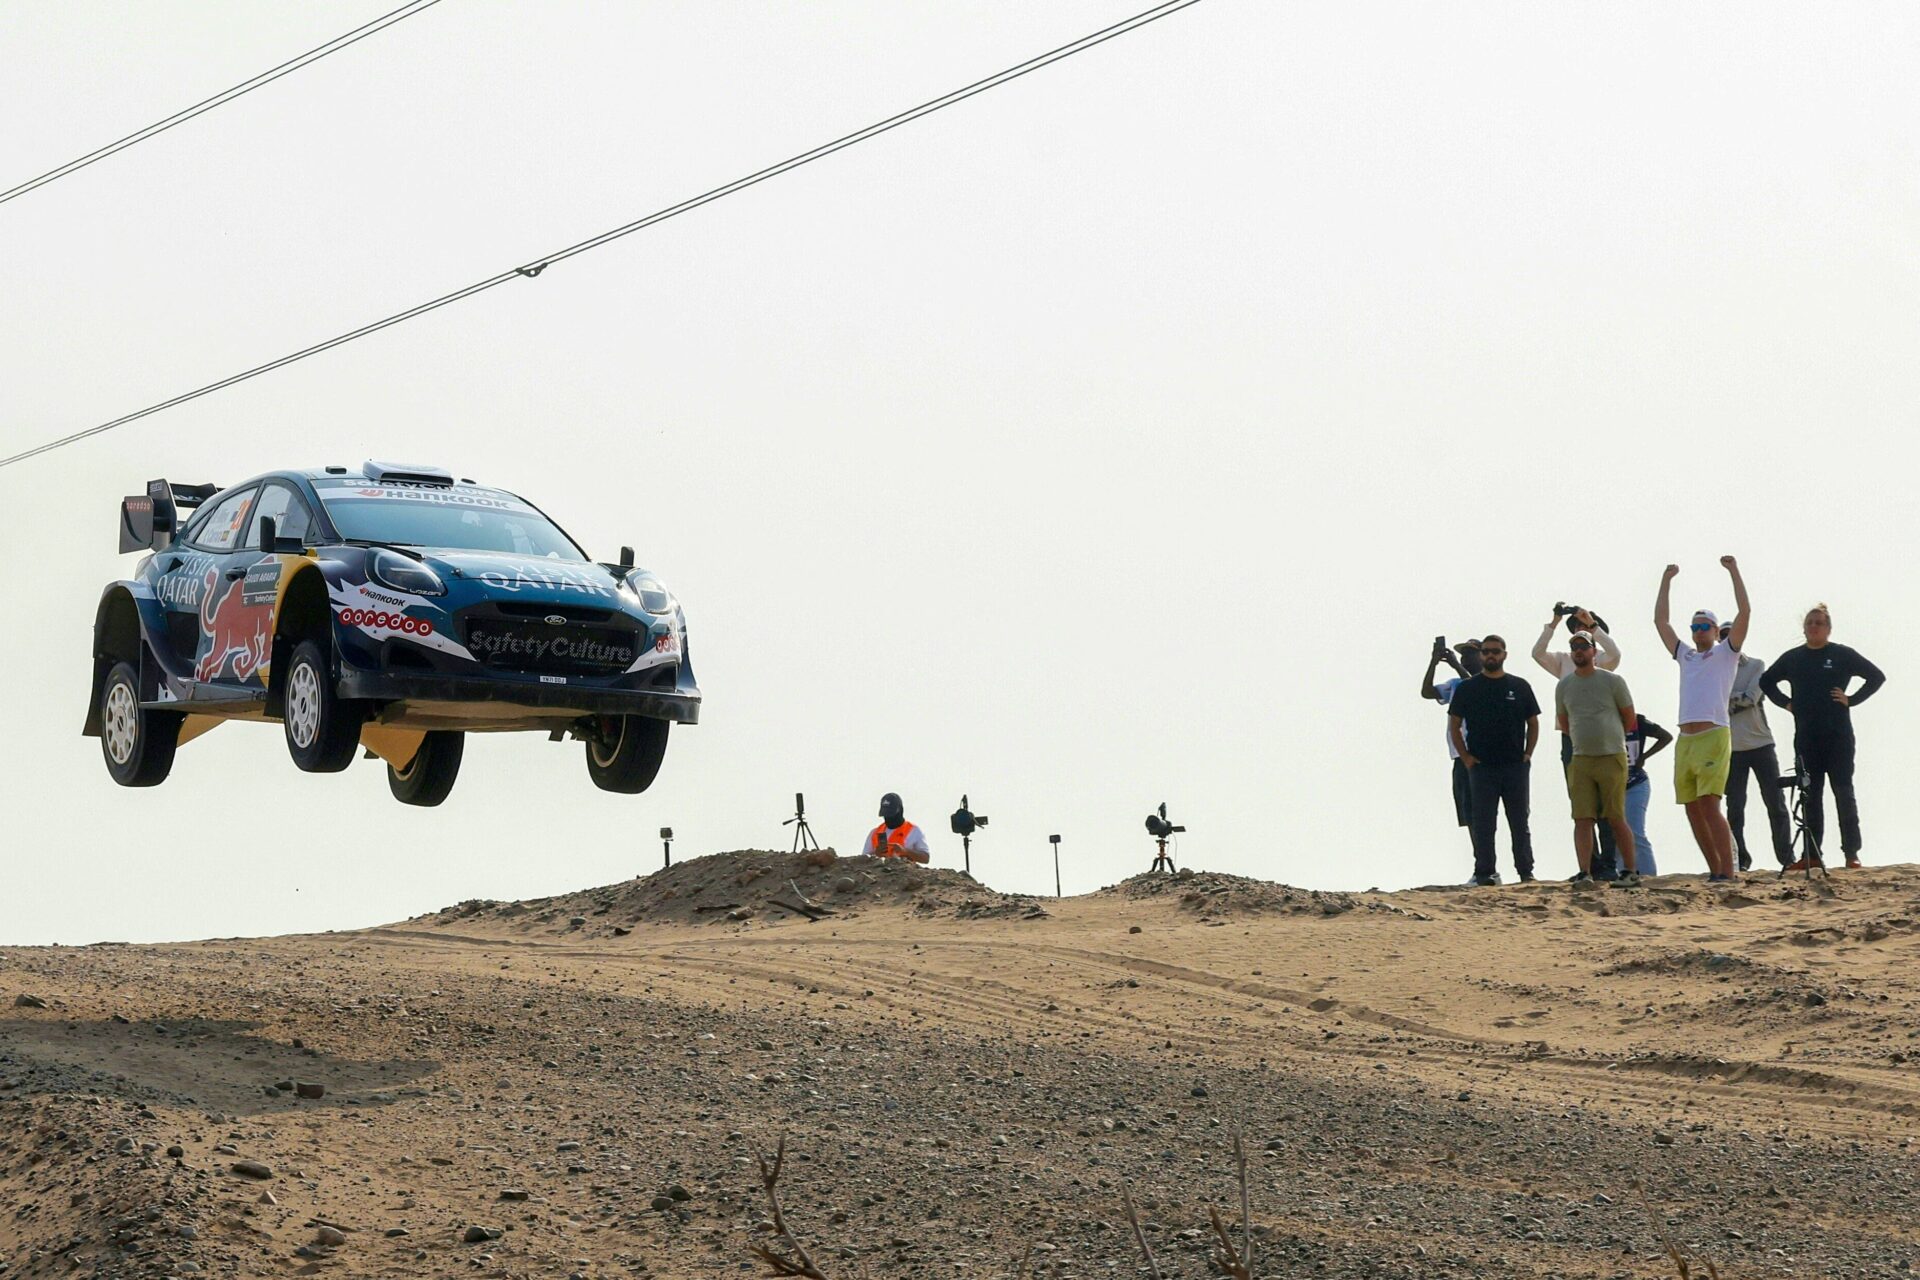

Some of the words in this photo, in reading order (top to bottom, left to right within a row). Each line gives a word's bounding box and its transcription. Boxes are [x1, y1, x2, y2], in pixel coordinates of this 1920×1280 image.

[157, 575, 199, 607] QATAR
[479, 571, 612, 598] QATAR
[342, 611, 430, 633] ooredoo
[469, 630, 632, 662] SafetyCulture
